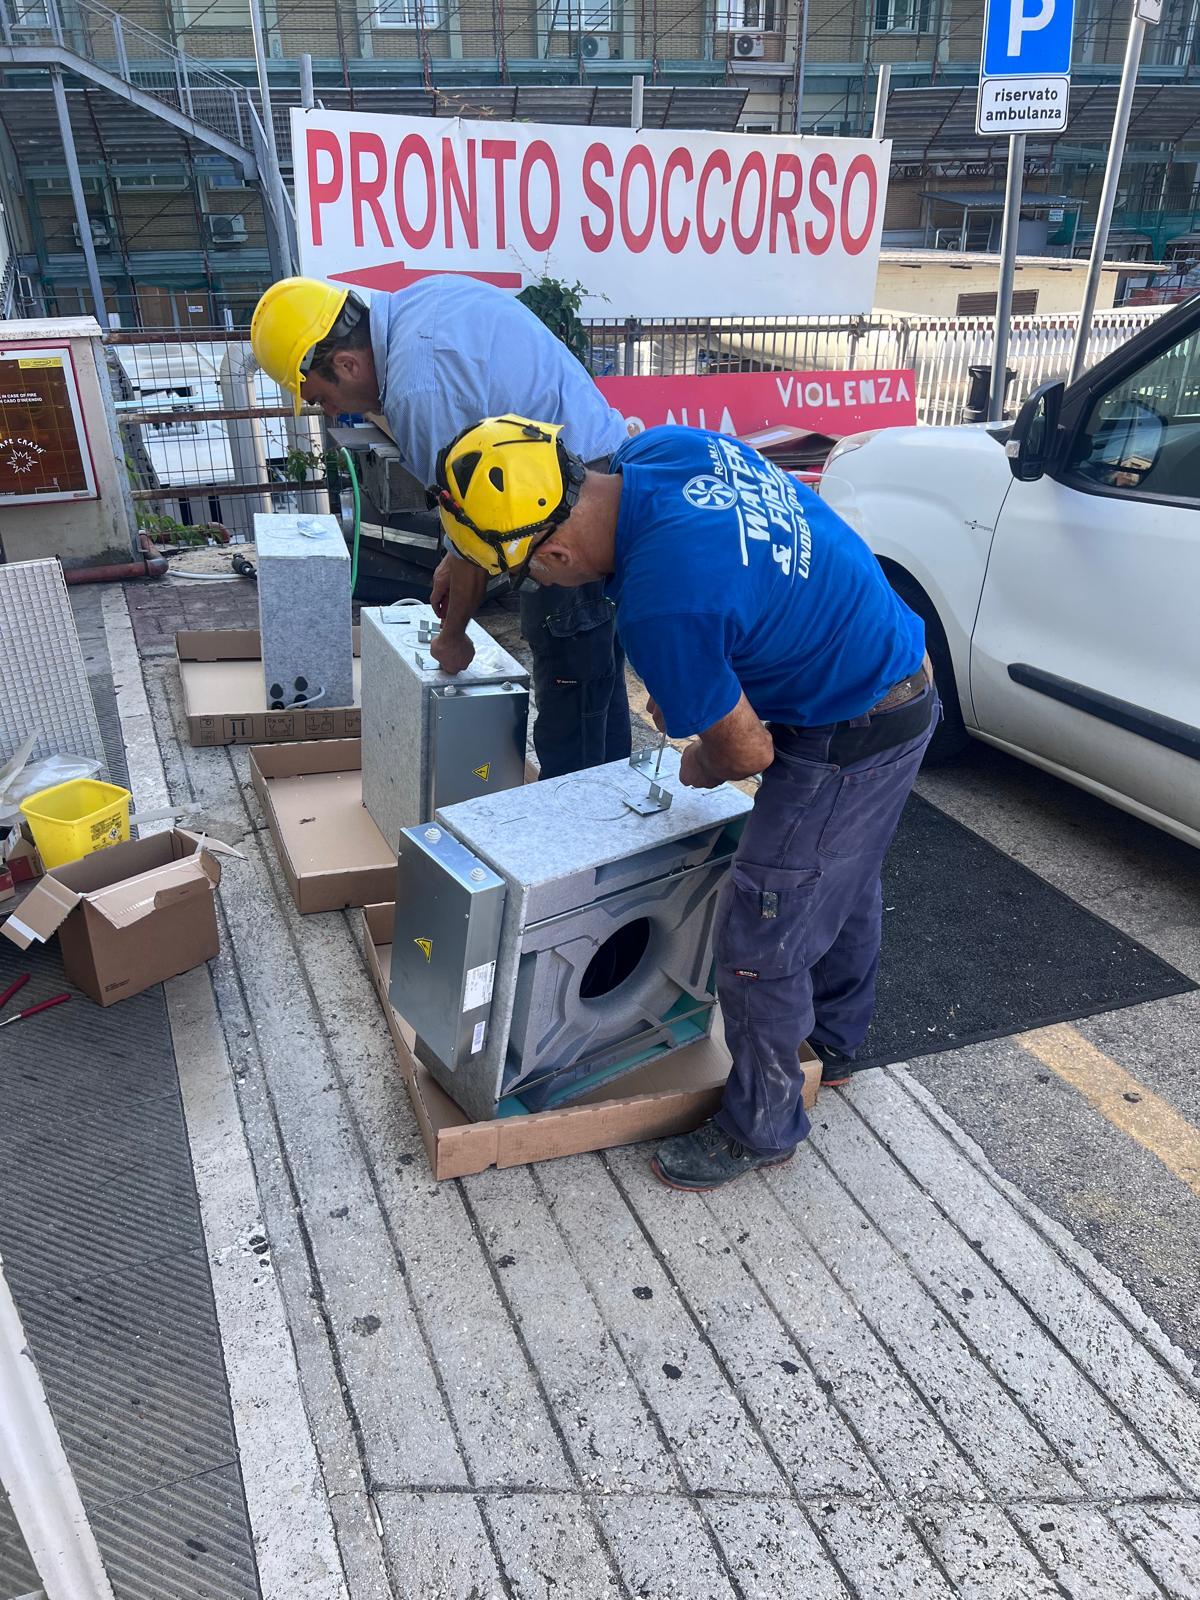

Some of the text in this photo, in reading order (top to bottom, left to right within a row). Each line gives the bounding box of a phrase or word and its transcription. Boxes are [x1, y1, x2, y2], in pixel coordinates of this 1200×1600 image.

[1006, 0, 1056, 57] P
[985, 106, 1062, 121] ambulanza
[994, 88, 1059, 102] riservato
[306, 129, 878, 257] PRONTO SOCCORSO
[776, 376, 910, 410] VIOLENZA
[17, 438, 44, 454] CRASH
[718, 438, 771, 542] WATER
[751, 465, 792, 576] & FIRE
[795, 514, 812, 579] UNDER
